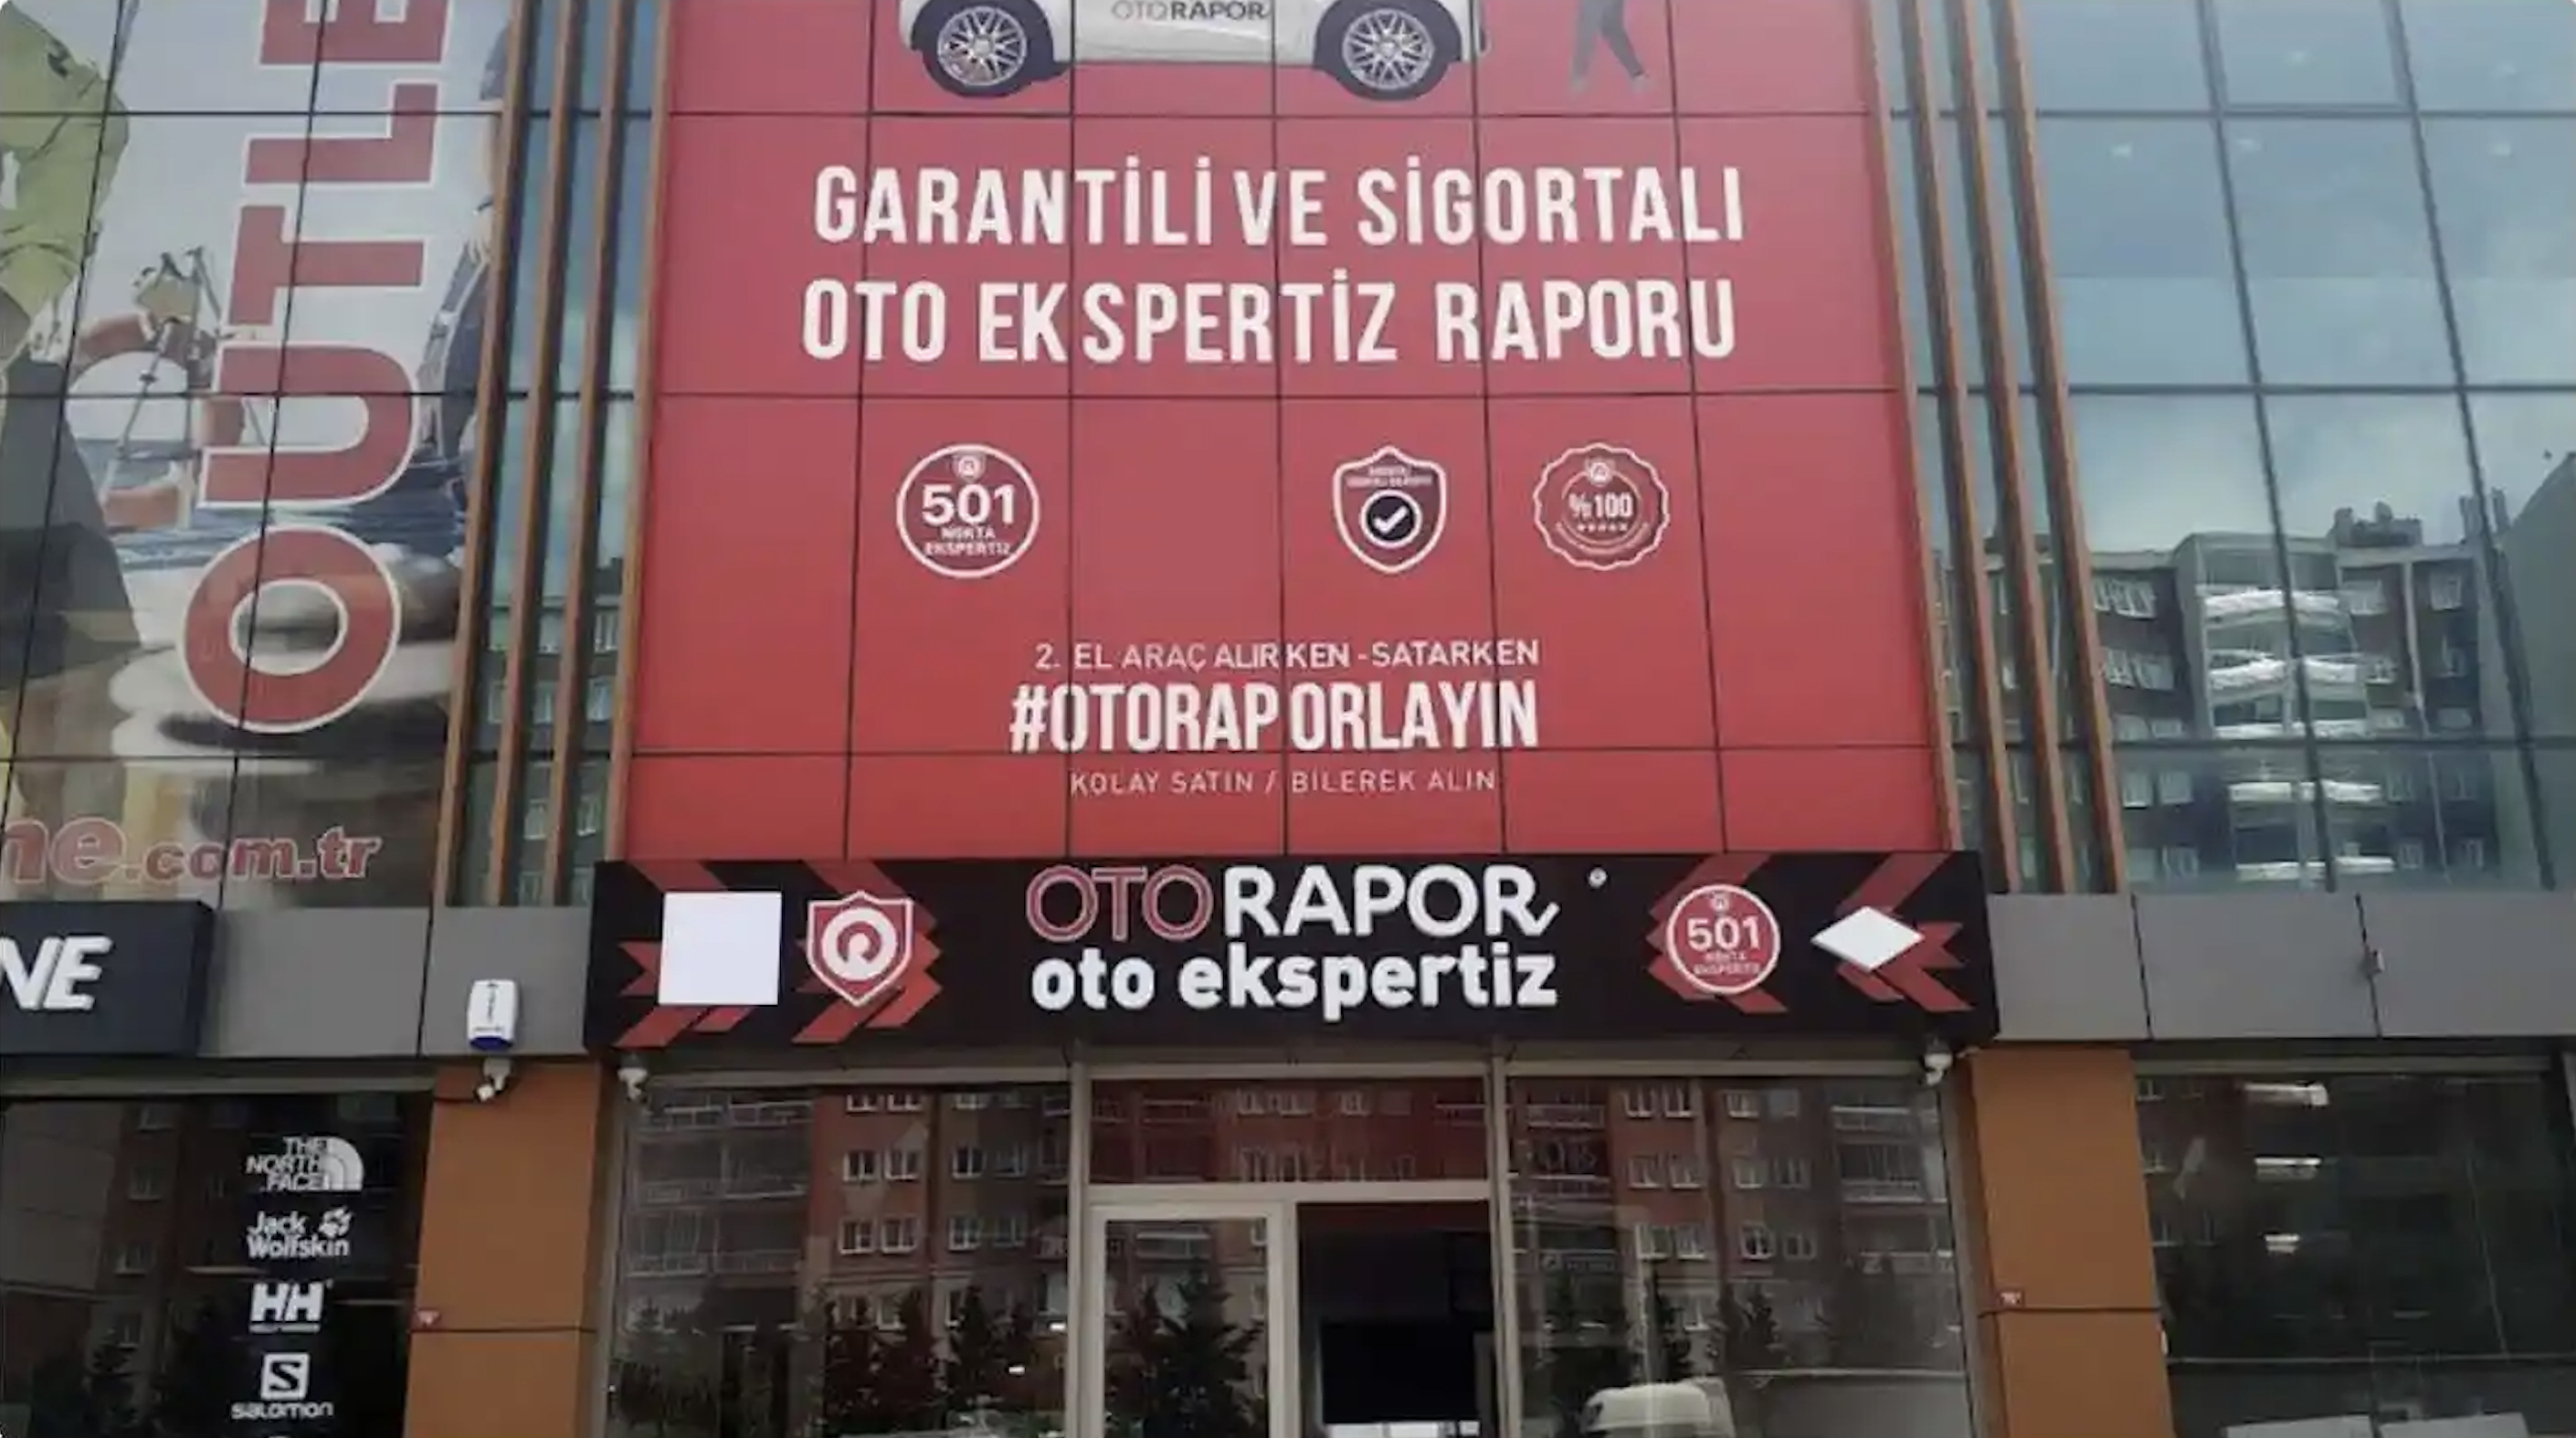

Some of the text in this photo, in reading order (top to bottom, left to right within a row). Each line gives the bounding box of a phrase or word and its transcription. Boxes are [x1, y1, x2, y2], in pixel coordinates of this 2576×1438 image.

[814, 156, 1743, 245] GARANTİLİ VE SİGORTALI
[803, 269, 1737, 363] OTO EKSPERTİZ RAPORU
[922, 484, 1015, 526] 501
[1568, 492, 1633, 517] %100
[1035, 644, 1061, 669] 2.
[1074, 644, 1112, 669] EL
[1122, 644, 1206, 673] ARAÇ
[1215, 642, 1350, 669] ALIRKEN
[1009, 681, 1538, 753] #OTORAPORLAYIN
[1070, 770, 1158, 795] KOLAY
[1171, 769, 1253, 794] SATIN
[1292, 767, 1414, 794] BİLEREK
[1428, 768, 1496, 792] ALIN
[1686, 915, 1760, 952] 501
[1031, 942, 1557, 1021] oto ekspertiz
[282, 1137, 327, 1155] THE
[245, 1155, 322, 1174] NORTH
[264, 1173, 326, 1191] FACE
[248, 1211, 308, 1235] Jack
[247, 1234, 350, 1259] Wolfskin
[249, 1282, 325, 1322] HH
[230, 1401, 335, 1421] salomon
